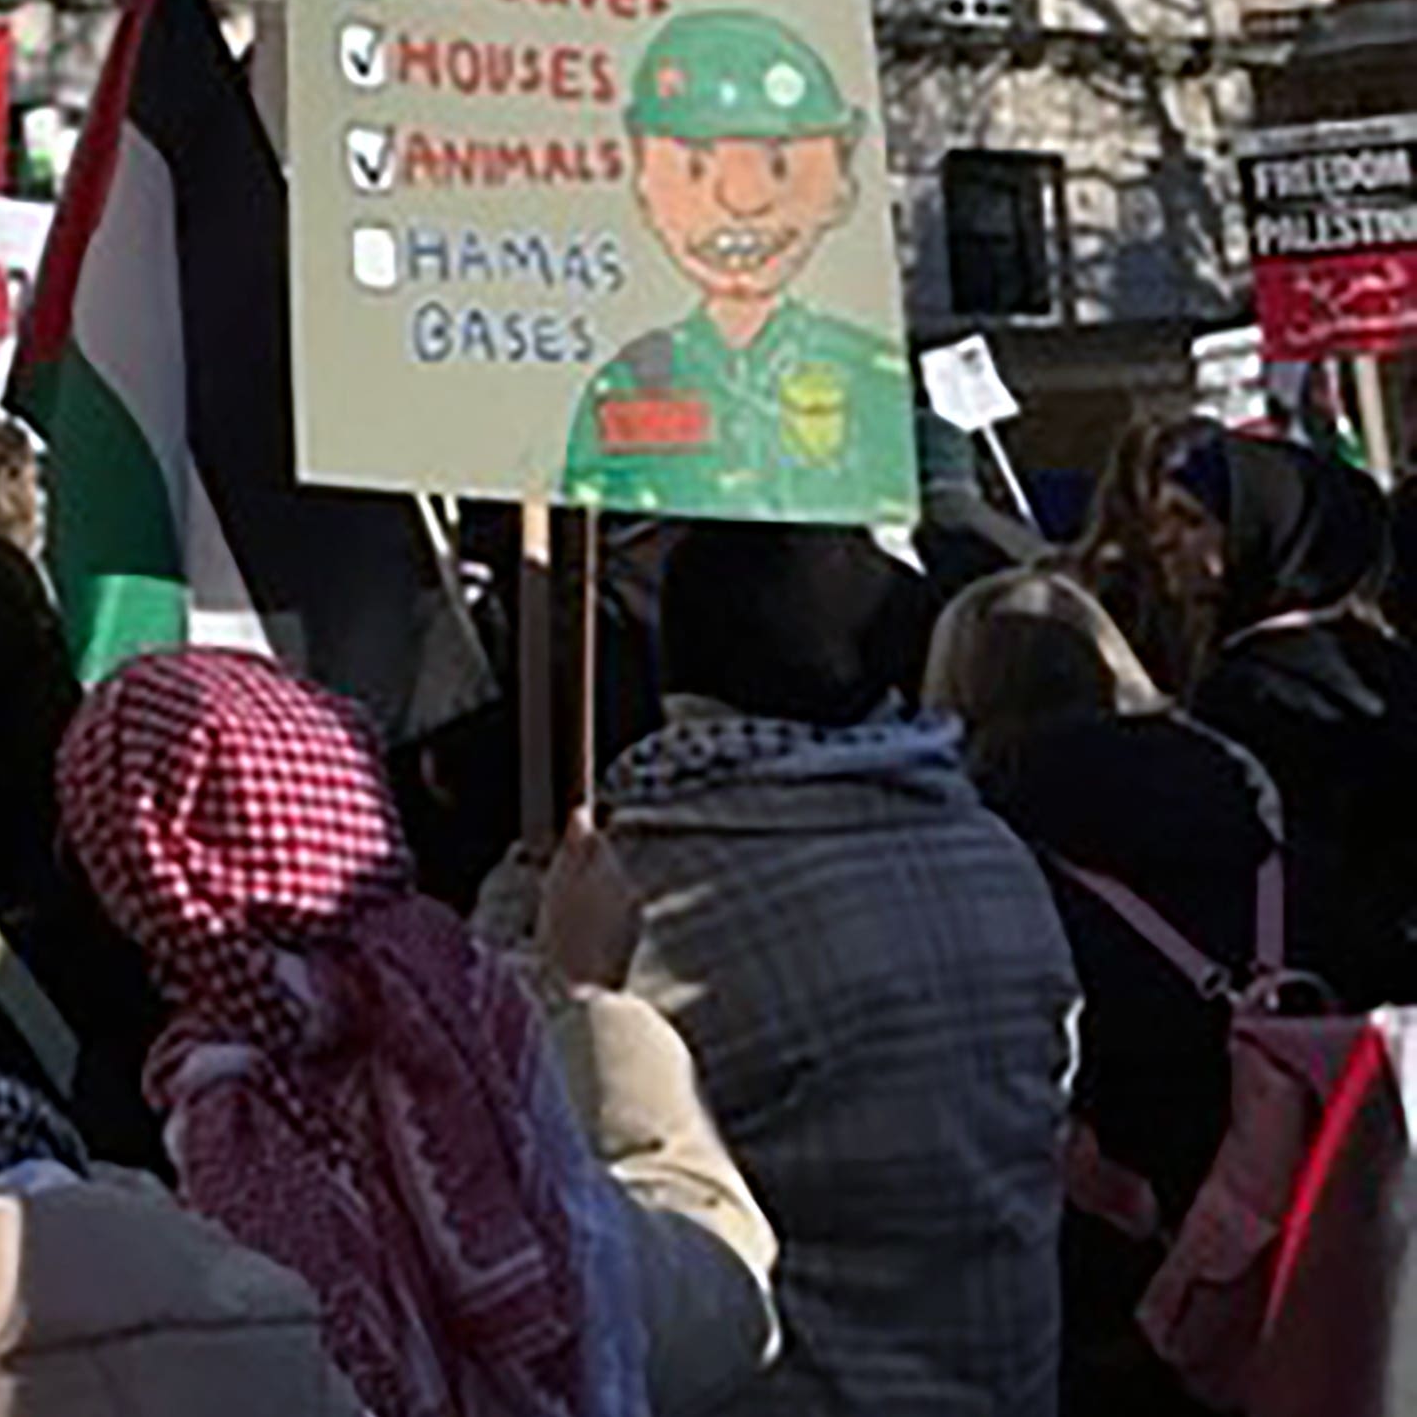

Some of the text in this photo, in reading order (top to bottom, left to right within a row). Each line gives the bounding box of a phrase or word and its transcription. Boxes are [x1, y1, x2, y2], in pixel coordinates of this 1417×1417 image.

[395, 34, 616, 103] HOUSES
[402, 132, 623, 186] ANIMALS
[407, 227, 624, 293] HAMAS
[413, 299, 596, 363] BASES
